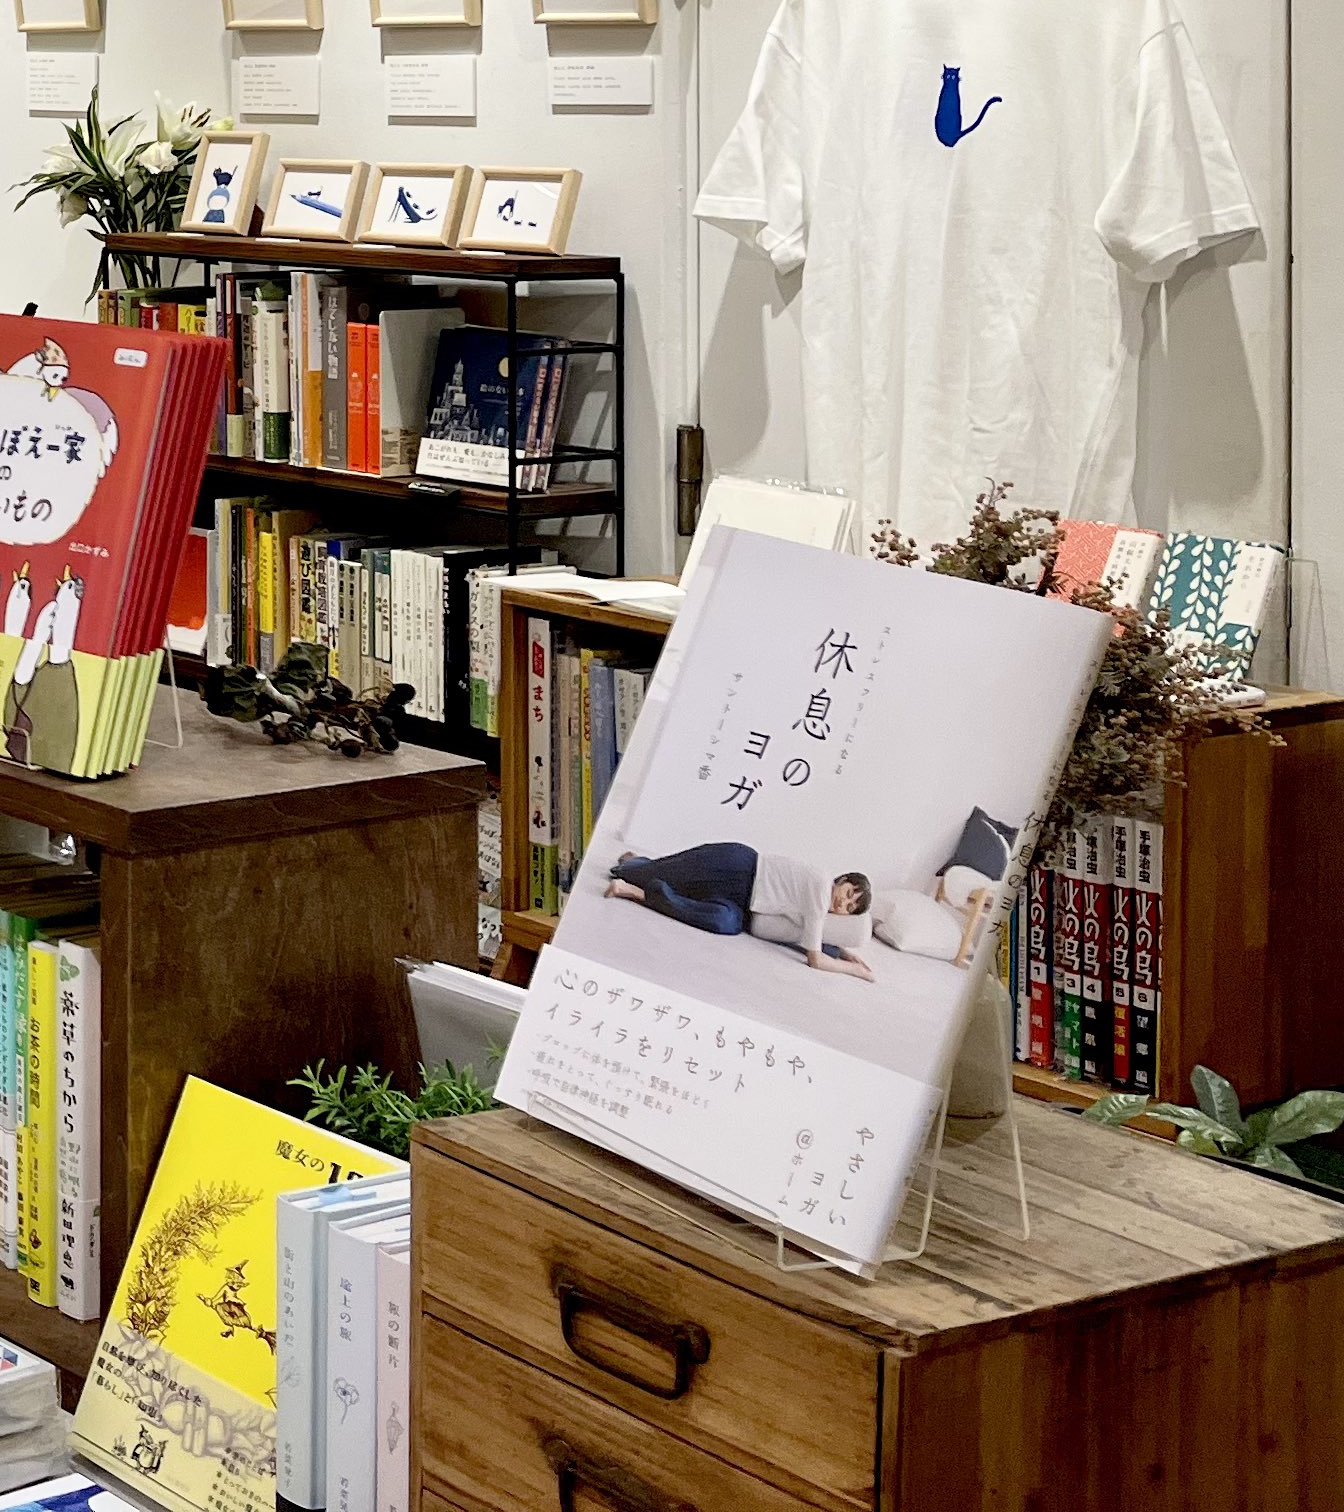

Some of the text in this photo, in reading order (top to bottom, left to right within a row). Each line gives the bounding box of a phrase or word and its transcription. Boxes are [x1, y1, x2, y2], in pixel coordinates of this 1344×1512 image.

[533, 686, 544, 722] まち
[782, 628, 859, 787] 休息の
[720, 730, 772, 811] ヨガ
[1138, 829, 1151, 884] 手塚治虫
[1031, 869, 1046, 960] 火の鳥
[1063, 879, 1080, 971] 火の鳥
[1083, 884, 1100, 976] 火の鳥
[1113, 888, 1129, 981] 火の鳥
[1135, 893, 1153, 986] 火の鳥
[554, 968, 813, 1084] 心のザワザワ、もやもや、
[1066, 978, 1076, 988] 3
[1086, 983, 1097, 993] 4
[29, 1016, 41, 1109] お茶の時間
[60, 991, 80, 1132] 薬草のちから
[547, 1003, 746, 1093] イライラをリセット
[799, 1172, 825, 1215] ヨガ
[828, 1127, 874, 1226] やさしい
[339, 1276, 353, 1343] 途上の旅
[387, 1300, 401, 1369] 旅の断片
